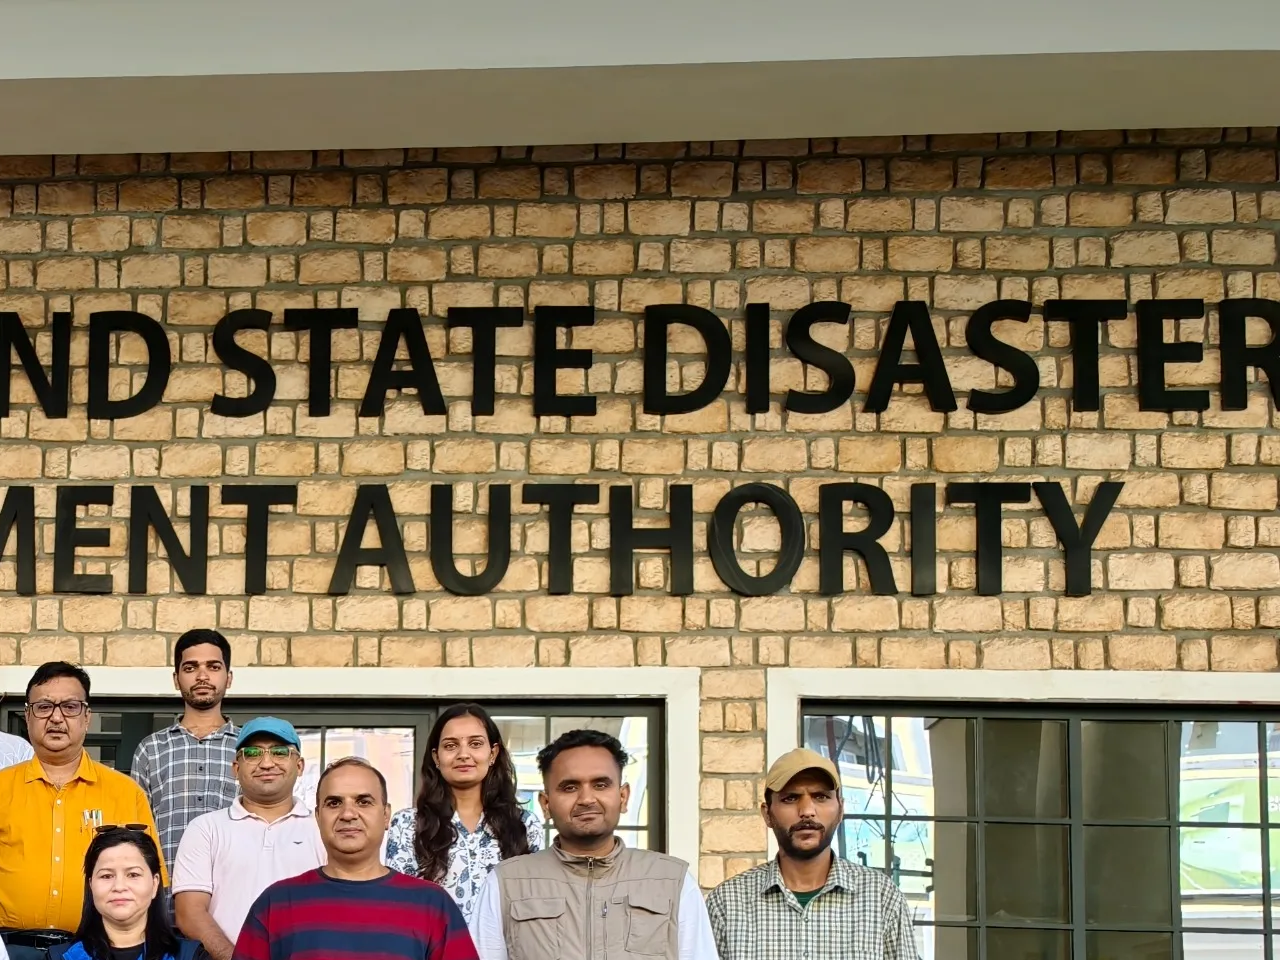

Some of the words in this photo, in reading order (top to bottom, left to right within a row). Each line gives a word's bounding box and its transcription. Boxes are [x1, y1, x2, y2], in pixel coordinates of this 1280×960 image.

[211, 302, 598, 419] STATE
[643, 297, 1280, 416] DISASTER
[327, 481, 1126, 598] AUTHORITY
